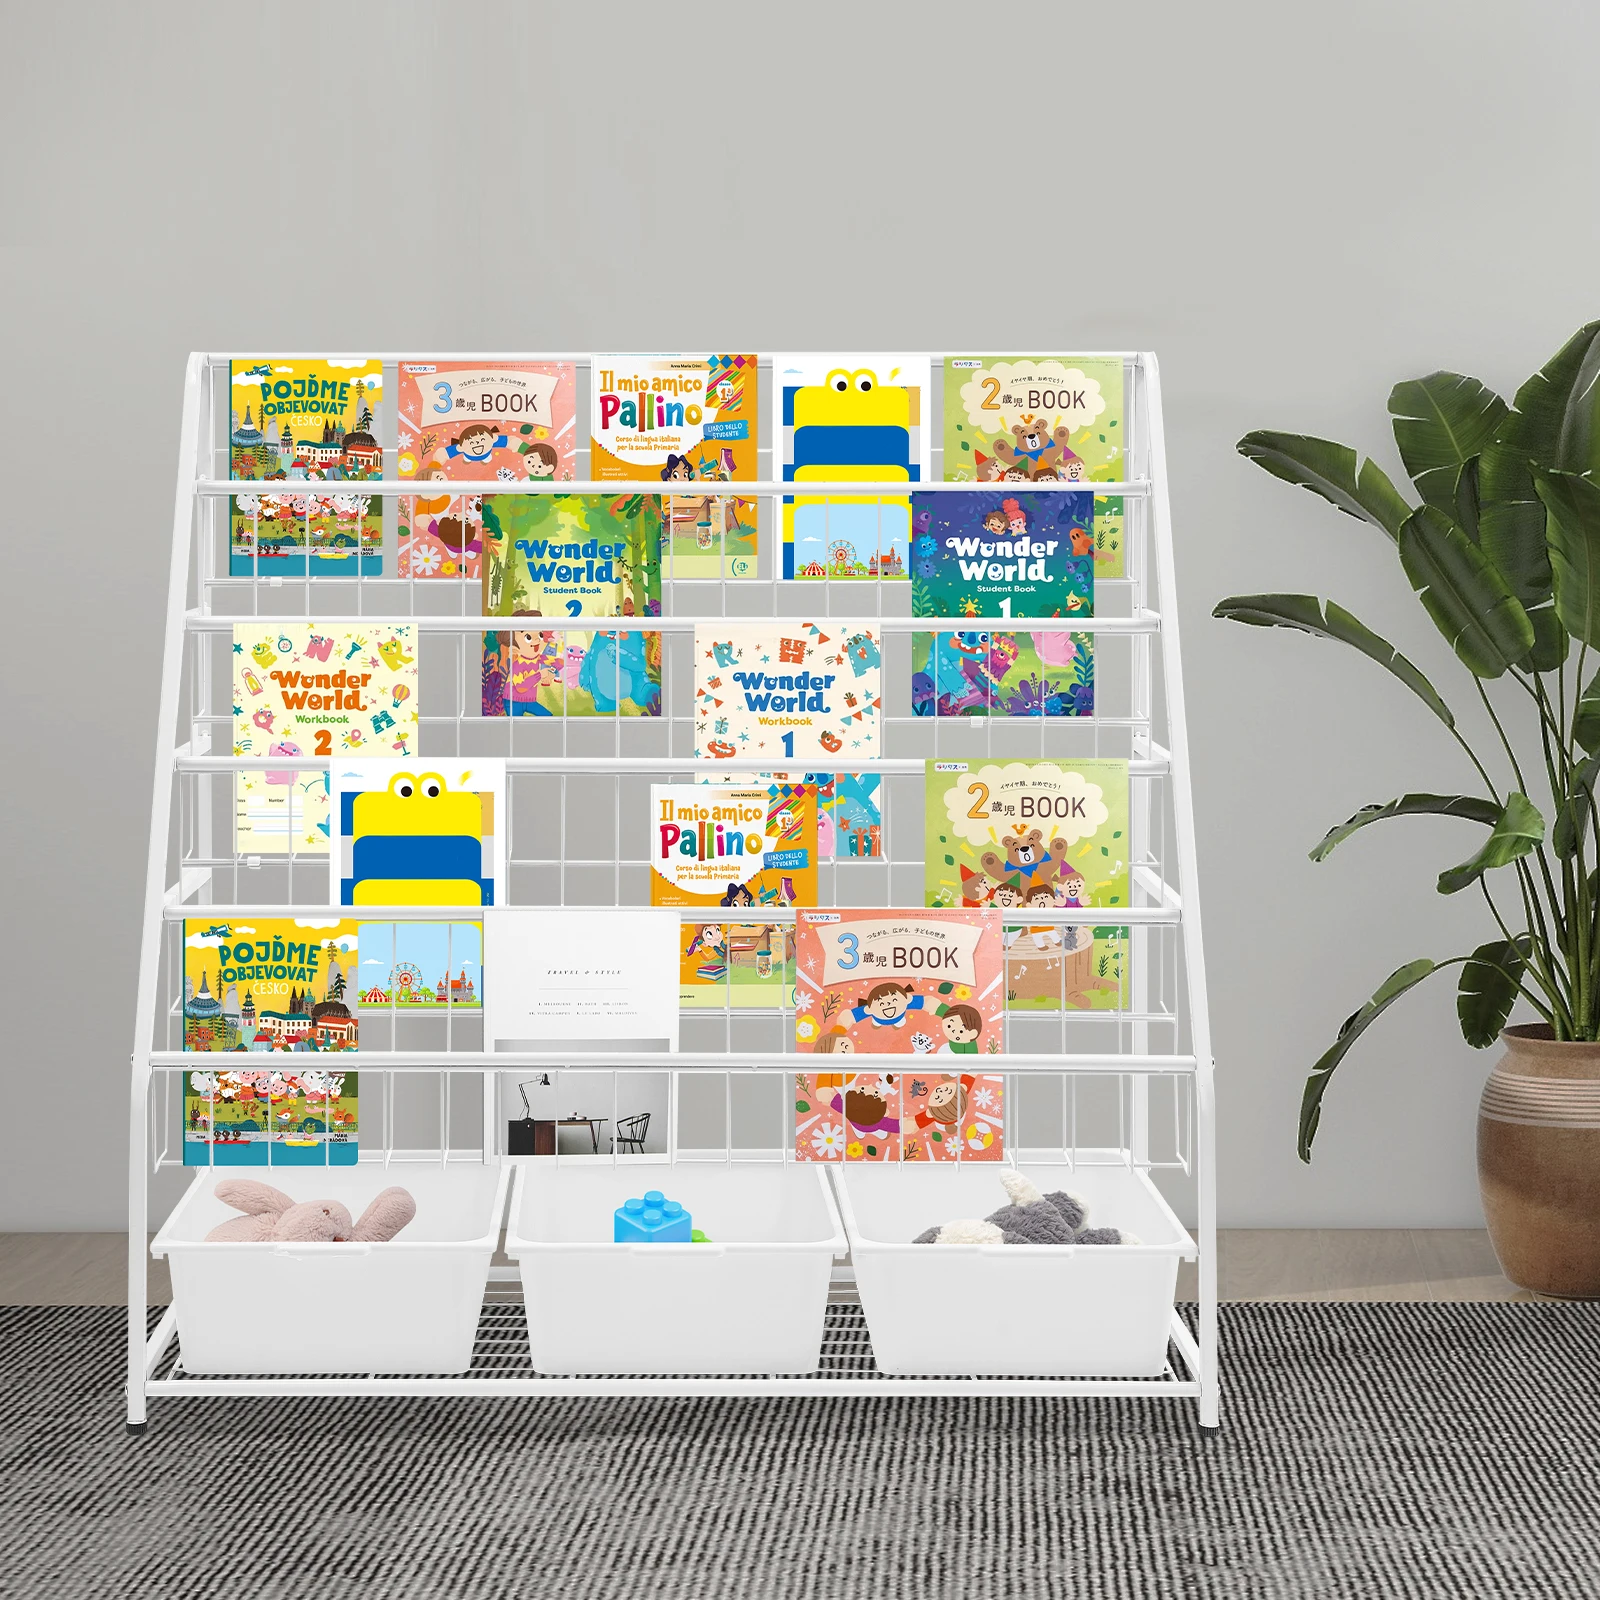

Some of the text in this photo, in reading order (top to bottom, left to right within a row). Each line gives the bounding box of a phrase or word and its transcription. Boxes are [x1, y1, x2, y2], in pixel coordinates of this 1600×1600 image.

[260, 374, 350, 401] POJĎME
[600, 370, 703, 397] Il mio amico
[263, 400, 348, 416] OBJEVOVAT
[481, 393, 538, 413] BOOK
[1028, 390, 1085, 409] BOOK
[290, 413, 323, 427] ČESKO
[600, 392, 703, 432] Pallino
[707, 422, 743, 432] LIBRO DELLO
[712, 431, 739, 439] STUDENTE
[616, 443, 680, 452] per la scuola Primaria
[633, 435, 640, 443] di
[640, 435, 659, 444] lingua
[659, 435, 681, 443] italiana
[515, 539, 626, 560] Wonder
[946, 536, 1059, 558] Wonder
[527, 560, 622, 584] World
[959, 558, 1054, 583] World
[543, 586, 602, 594] Student Book
[998, 597, 1011, 618] 1
[270, 669, 372, 689] Wonder
[733, 671, 836, 691] Wonder
[281, 689, 368, 711] World
[744, 691, 831, 713] World
[295, 714, 349, 724] Workbook
[758, 717, 813, 726] Workbook
[314, 729, 332, 756] 2
[781, 730, 794, 757] 1
[659, 799, 762, 825] Il mio amico
[1021, 797, 1086, 818] BOOK
[660, 821, 762, 861] Pallino
[767, 852, 803, 861] LIBRO DELLO
[772, 860, 799, 868] STUDENTE
[675, 864, 692, 872] Corso
[700, 864, 718, 873] lingua
[718, 864, 741, 872] italiana
[677, 873, 688, 881] per
[218, 934, 322, 966] POJĎME
[893, 947, 959, 968] BOOK
[222, 965, 318, 983] OBJEVOVAT
[253, 980, 289, 995] ČESKO
